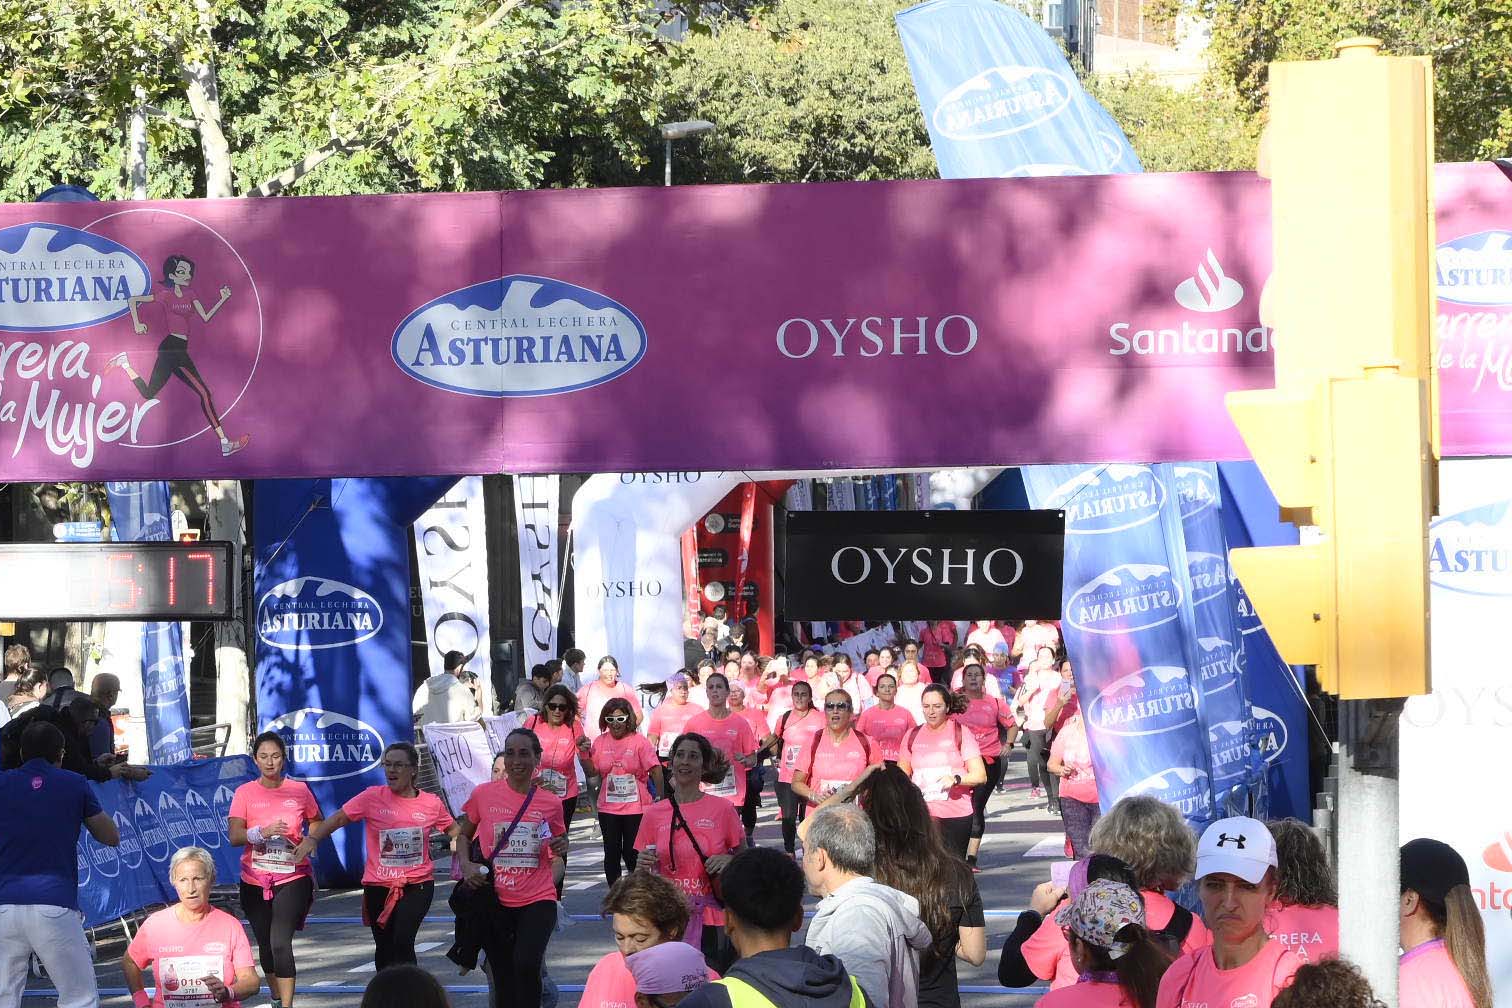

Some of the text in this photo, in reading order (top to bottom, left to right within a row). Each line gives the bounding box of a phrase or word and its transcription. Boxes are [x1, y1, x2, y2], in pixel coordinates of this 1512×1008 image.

[54, 257, 126, 271] LECHERA
[449, 315, 619, 331] CENTRAL LECHERA
[410, 322, 627, 368] ASTURIANA
[775, 313, 979, 361] OYSHO
[1109, 321, 1276, 356] Santand
[12, 375, 160, 468] Mujer
[831, 546, 1024, 588] OYSHO
[587, 580, 663, 598] OYSHO
[273, 601, 369, 610] CENTRAL LECHERA
[261, 606, 374, 634] ASTURIANA
[320, 733, 370, 741] LECHERA
[510, 839, 528, 847] 016
[377, 866, 406, 878] SUMA
[181, 978, 202, 987] 016
